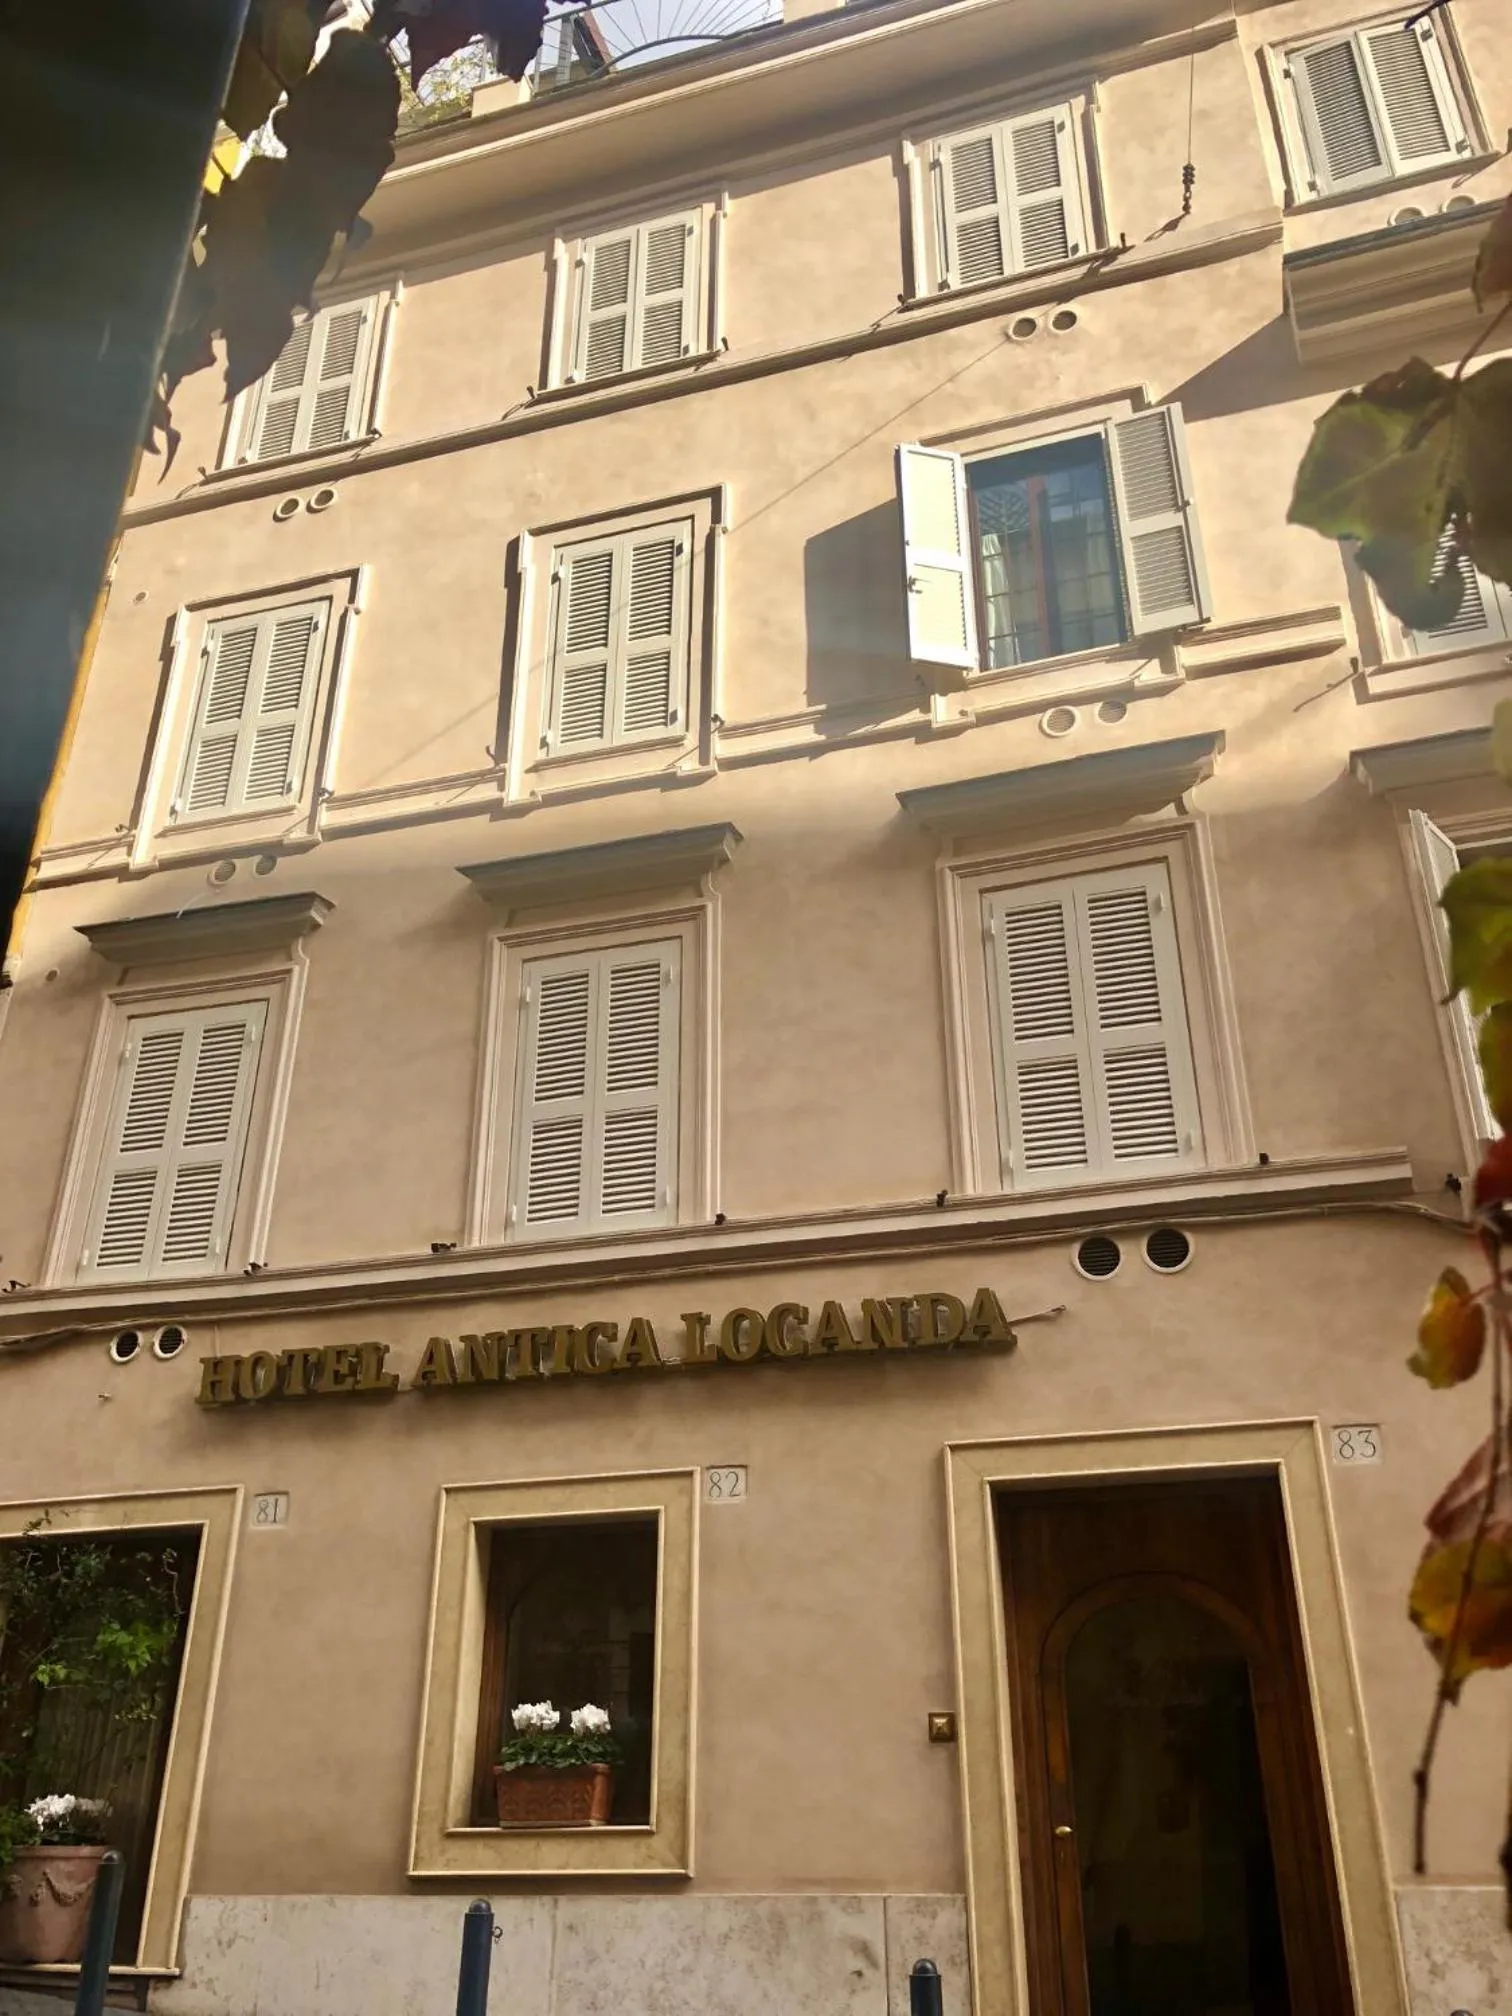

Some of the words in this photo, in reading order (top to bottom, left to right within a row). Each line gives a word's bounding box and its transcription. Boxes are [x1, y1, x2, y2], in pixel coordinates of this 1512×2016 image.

[199, 1341, 399, 1403] HOTEL
[411, 1316, 664, 1389] ANTICA
[680, 1287, 1016, 1366] LOCANDA
[1337, 1429, 1376, 1459] 83
[707, 1470, 741, 1498] 82
[255, 1497, 279, 1524] 81
